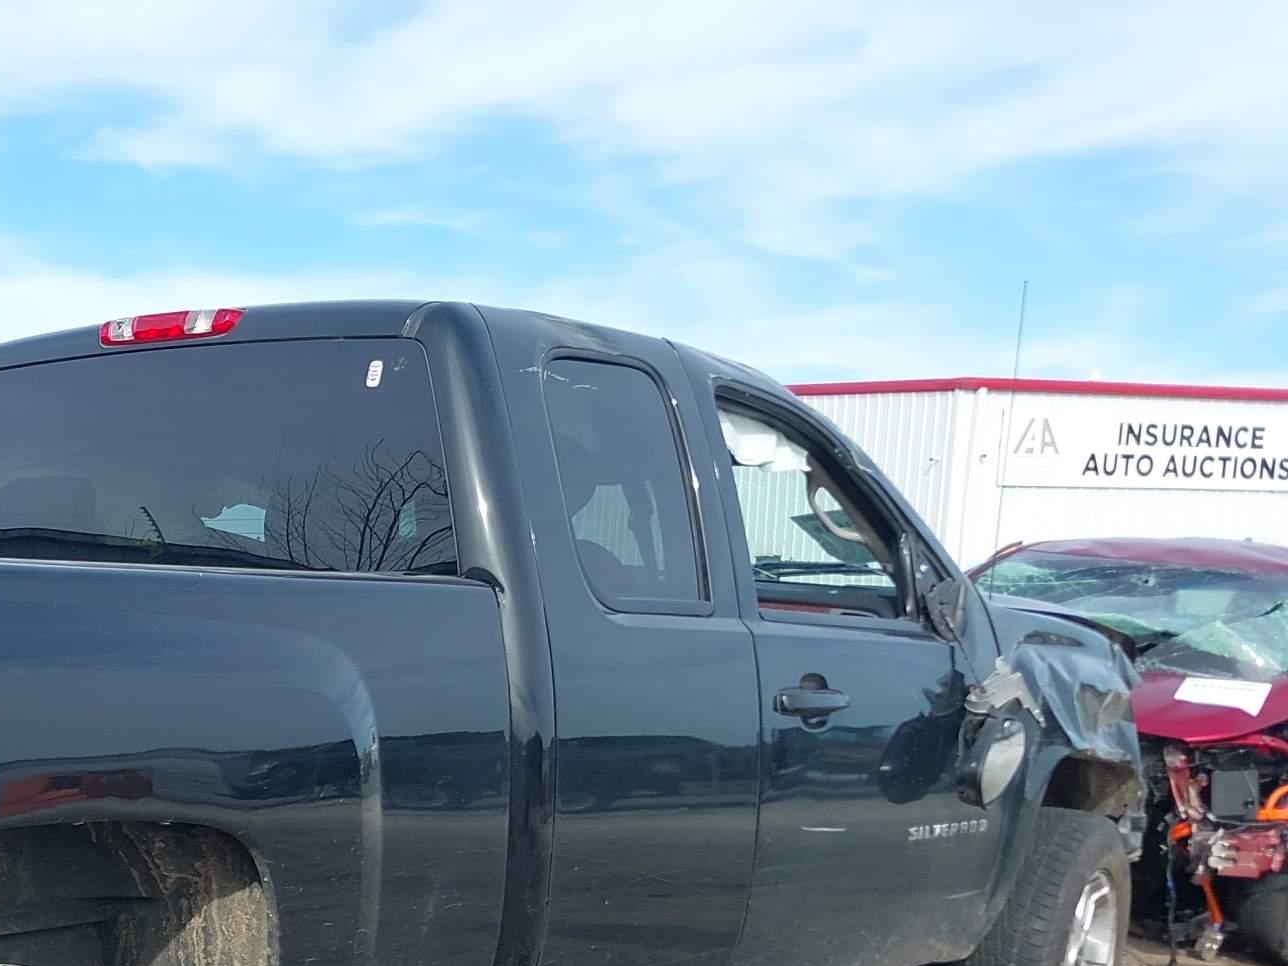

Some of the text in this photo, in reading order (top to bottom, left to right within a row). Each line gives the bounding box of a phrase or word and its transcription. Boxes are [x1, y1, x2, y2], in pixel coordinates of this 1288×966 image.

[1117, 422, 1265, 449] INSURANCE
[1081, 452, 1288, 480] AUTO AUCTIONS
[907, 819, 987, 841] SILVERADO
